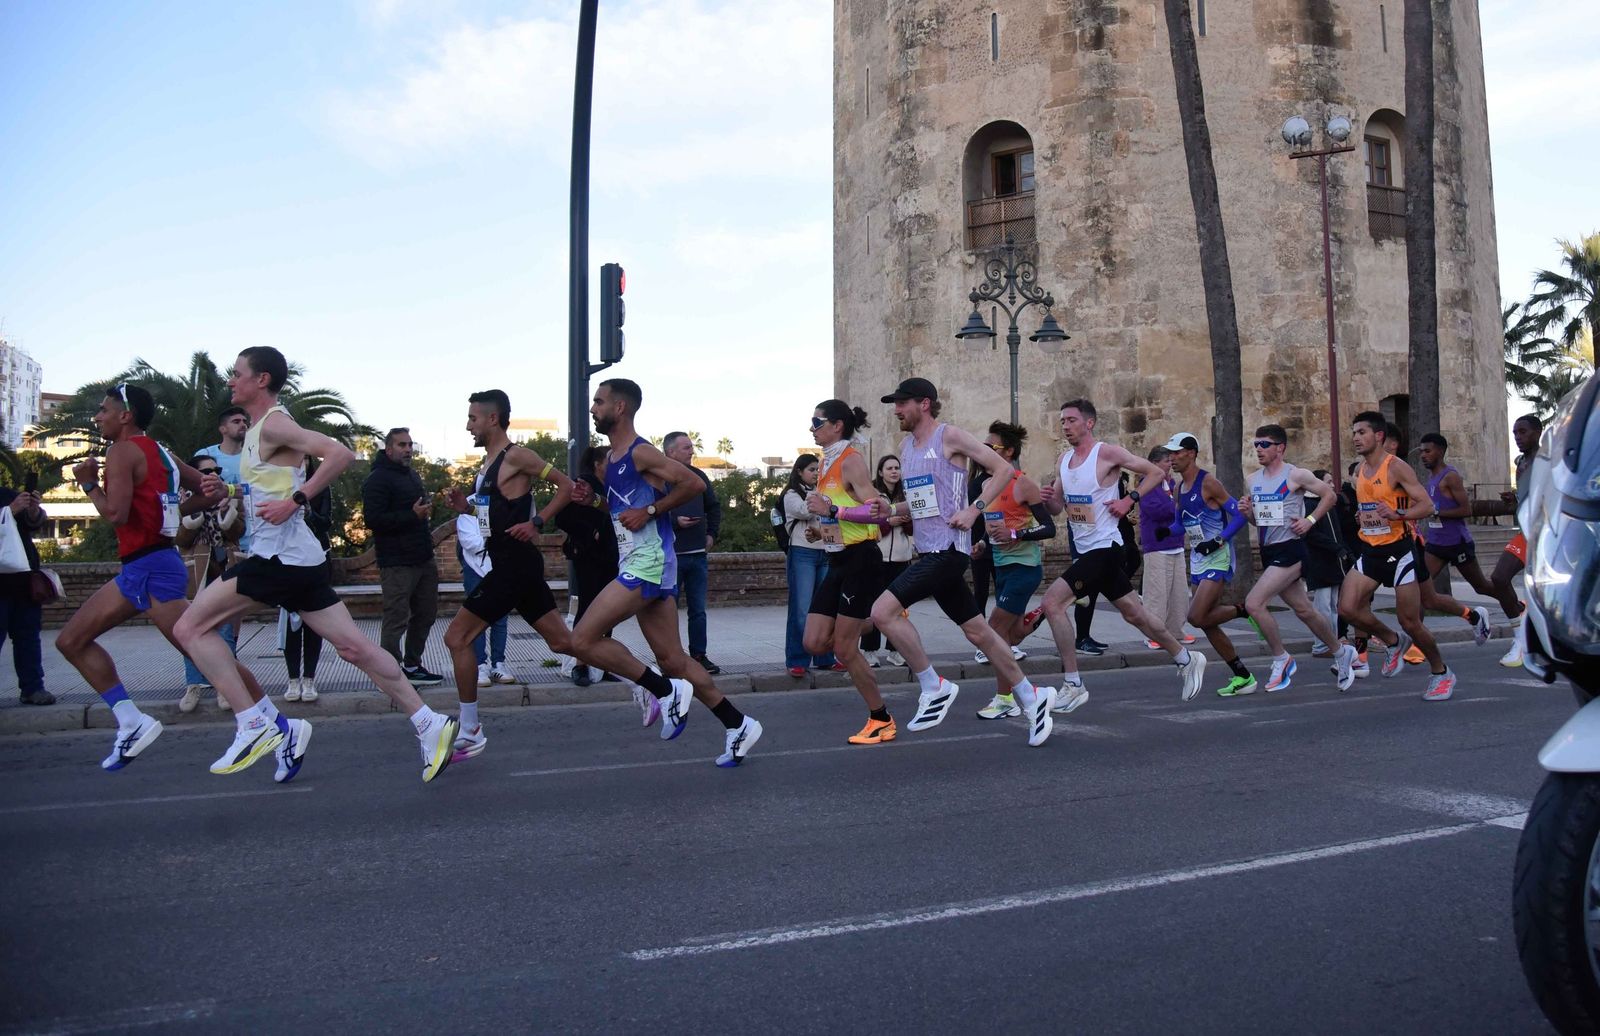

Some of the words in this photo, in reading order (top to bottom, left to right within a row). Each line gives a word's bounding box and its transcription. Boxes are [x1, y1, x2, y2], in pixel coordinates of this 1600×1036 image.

[908, 477, 928, 487] ZURICH
[911, 499, 926, 509] REED
[1071, 514, 1087, 522] RYAN
